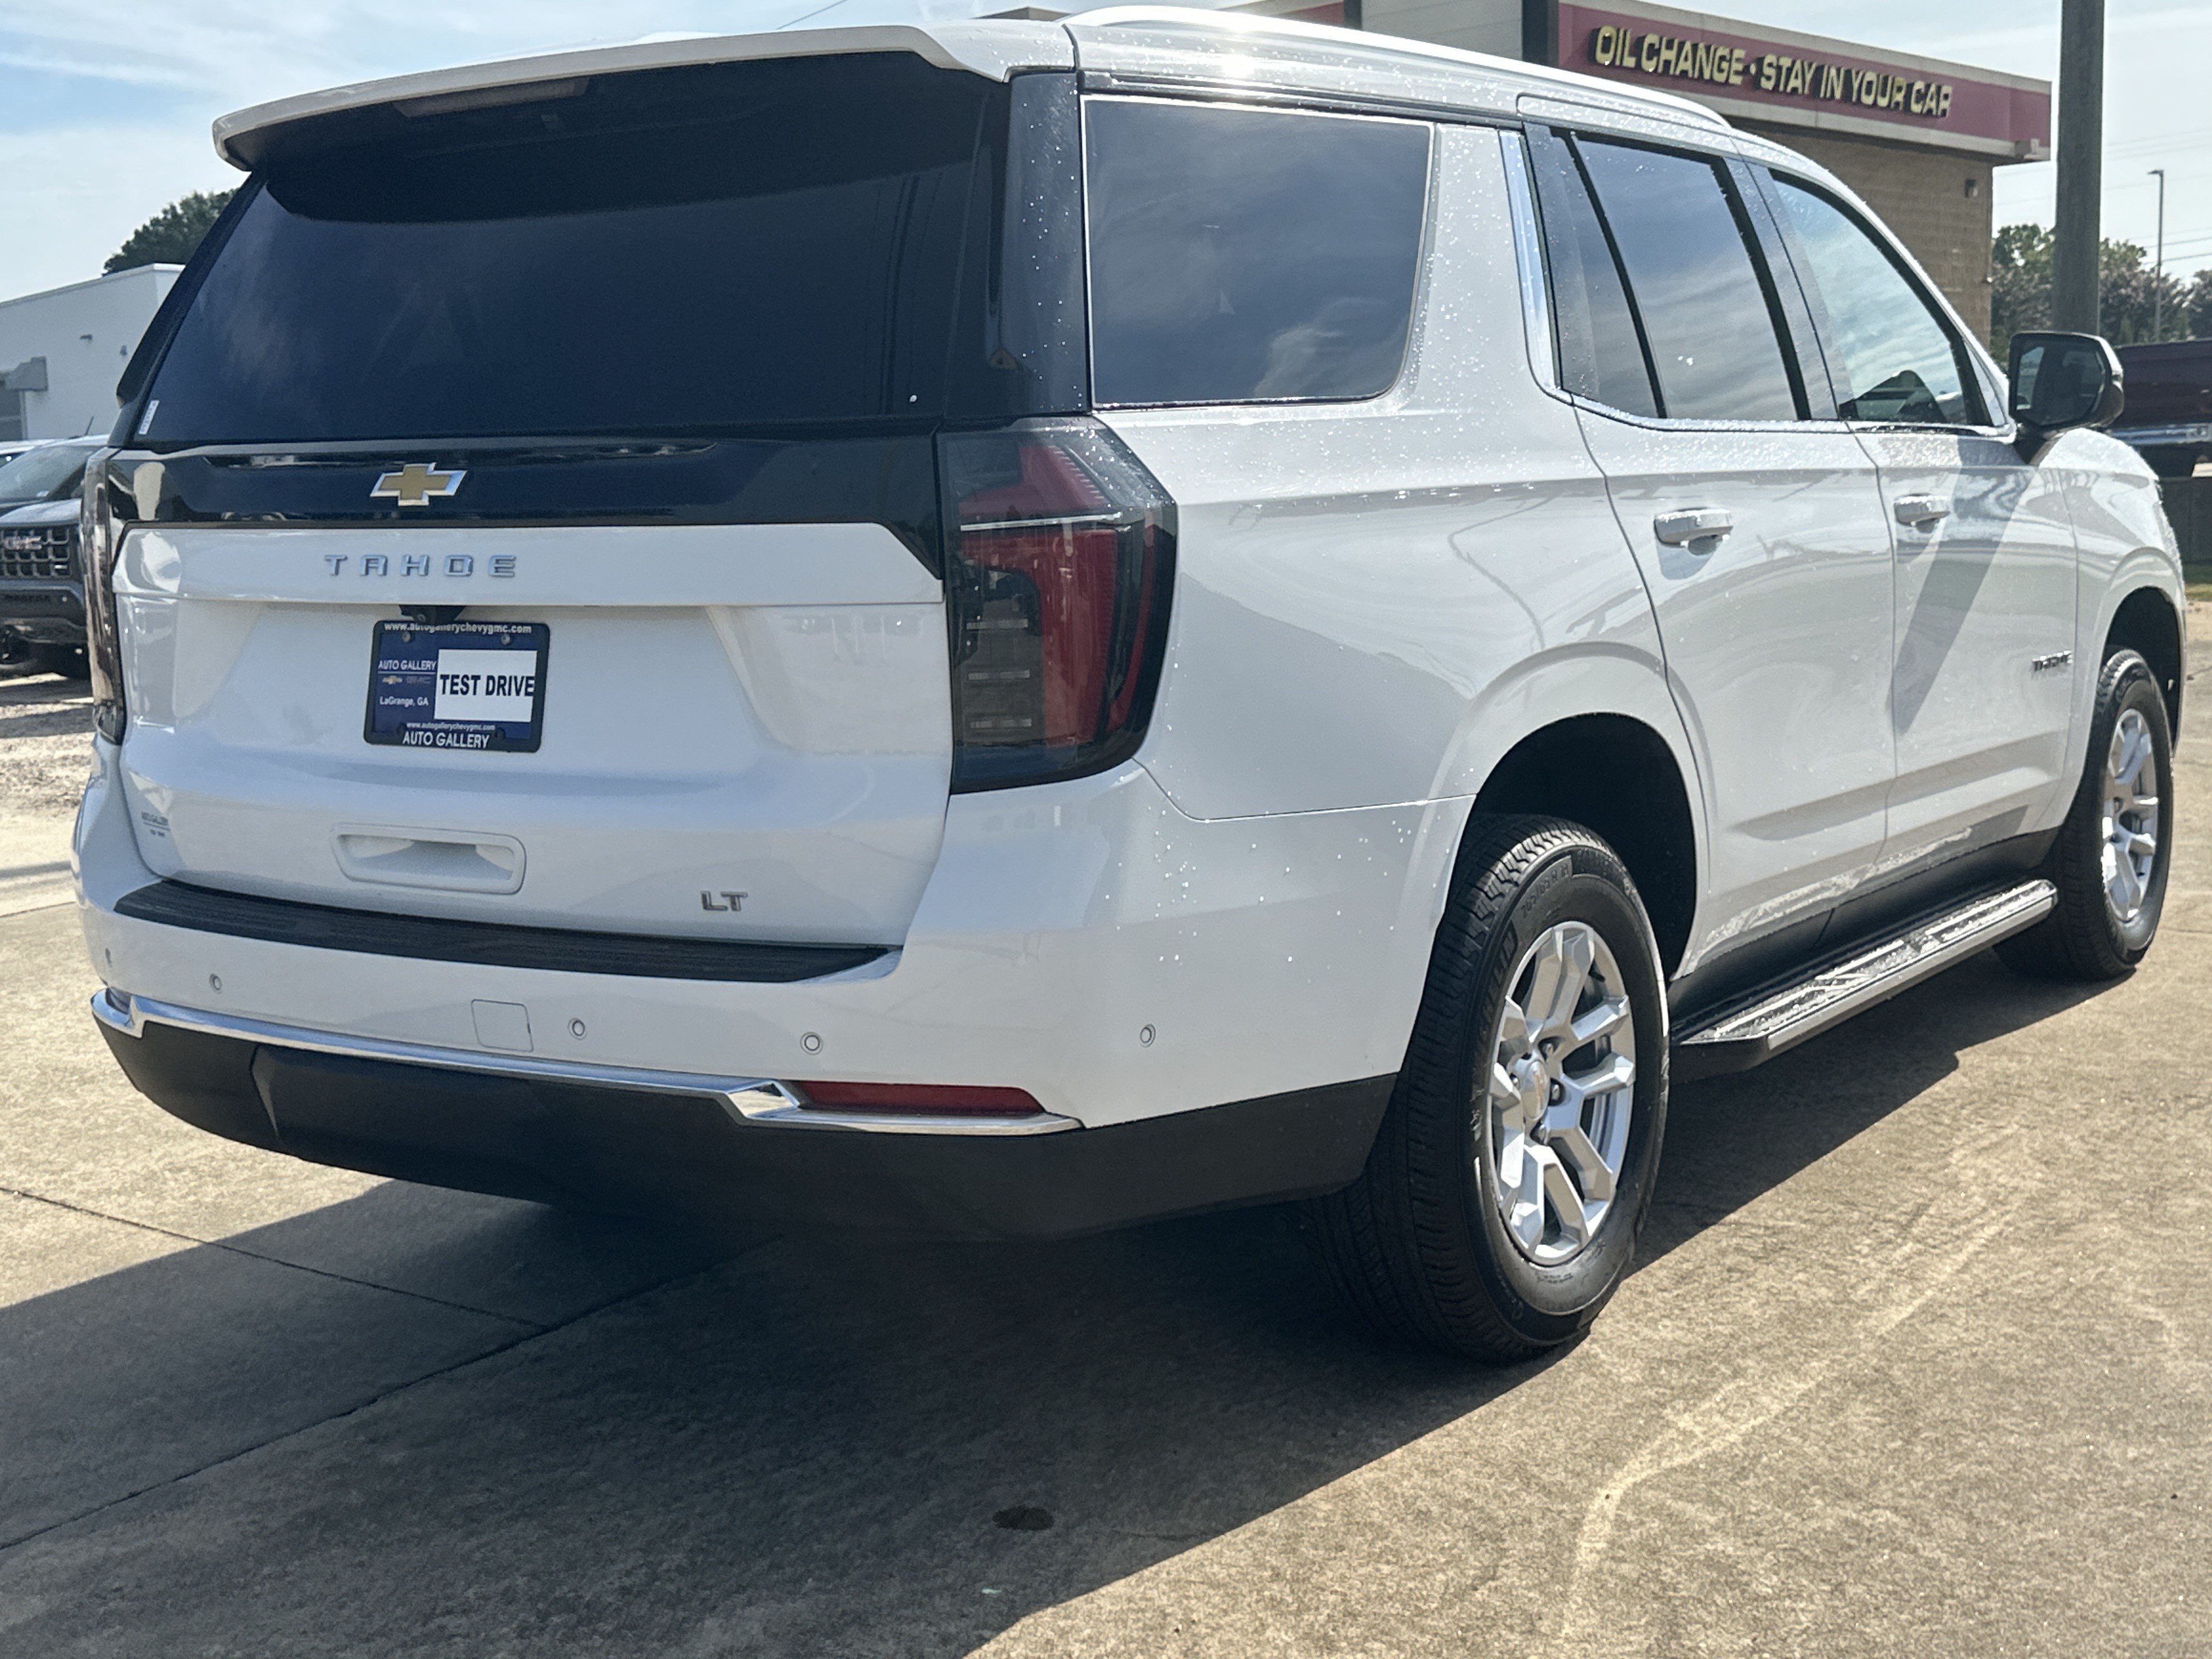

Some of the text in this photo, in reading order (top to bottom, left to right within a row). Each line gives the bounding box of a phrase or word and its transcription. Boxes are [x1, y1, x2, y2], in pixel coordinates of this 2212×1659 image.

[1595, 25, 1953, 117] OIL CHANGE STAY IN YOUR CAR
[324, 554, 517, 578] TAHOE
[378, 659, 437, 670] AUTO GALLERY
[440, 674, 535, 697] TEST DRIVE
[379, 696, 429, 708] LaGrange, GA
[402, 731, 490, 749] AUTO GALLERY
[701, 890, 748, 912] LT
